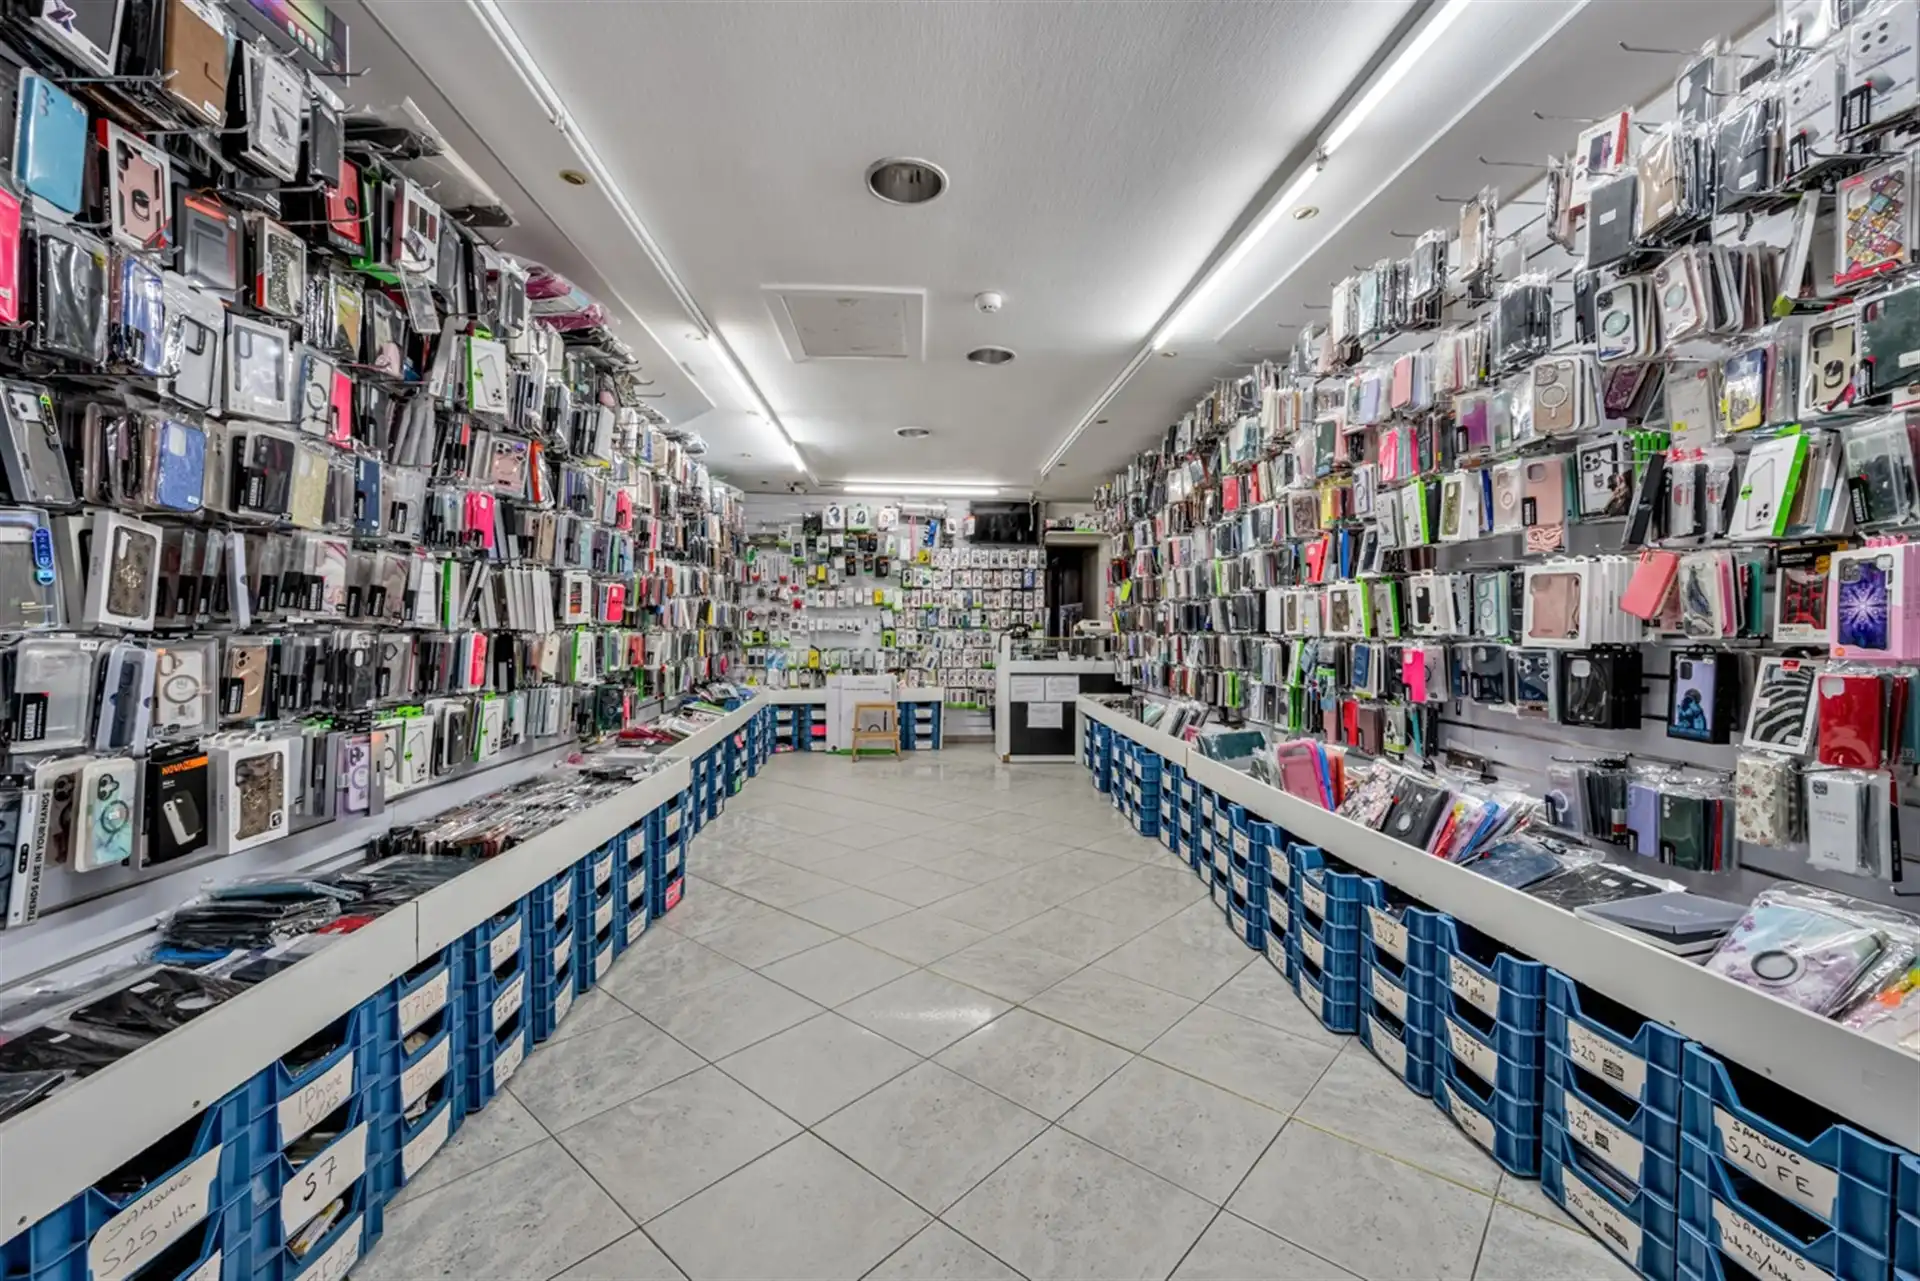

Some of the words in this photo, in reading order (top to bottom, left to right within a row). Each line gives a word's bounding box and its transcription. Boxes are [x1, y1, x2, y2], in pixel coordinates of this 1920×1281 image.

[40, 792, 50, 824] HANDS
[35, 853, 43, 861] IN
[36, 826, 46, 850] YOUR
[32, 864, 41, 882] ARE
[27, 884, 39, 922] TRENDS
[1571, 1038, 1596, 1063] S20
[1732, 1121, 1801, 1166] SAMSUNG
[1726, 1135, 1767, 1170] S20
[1777, 1165, 1815, 1198] FE
[106, 1174, 192, 1243] SAMSUNG
[100, 1224, 158, 1277] S25
[1730, 1211, 1806, 1272] SAMSUNG
